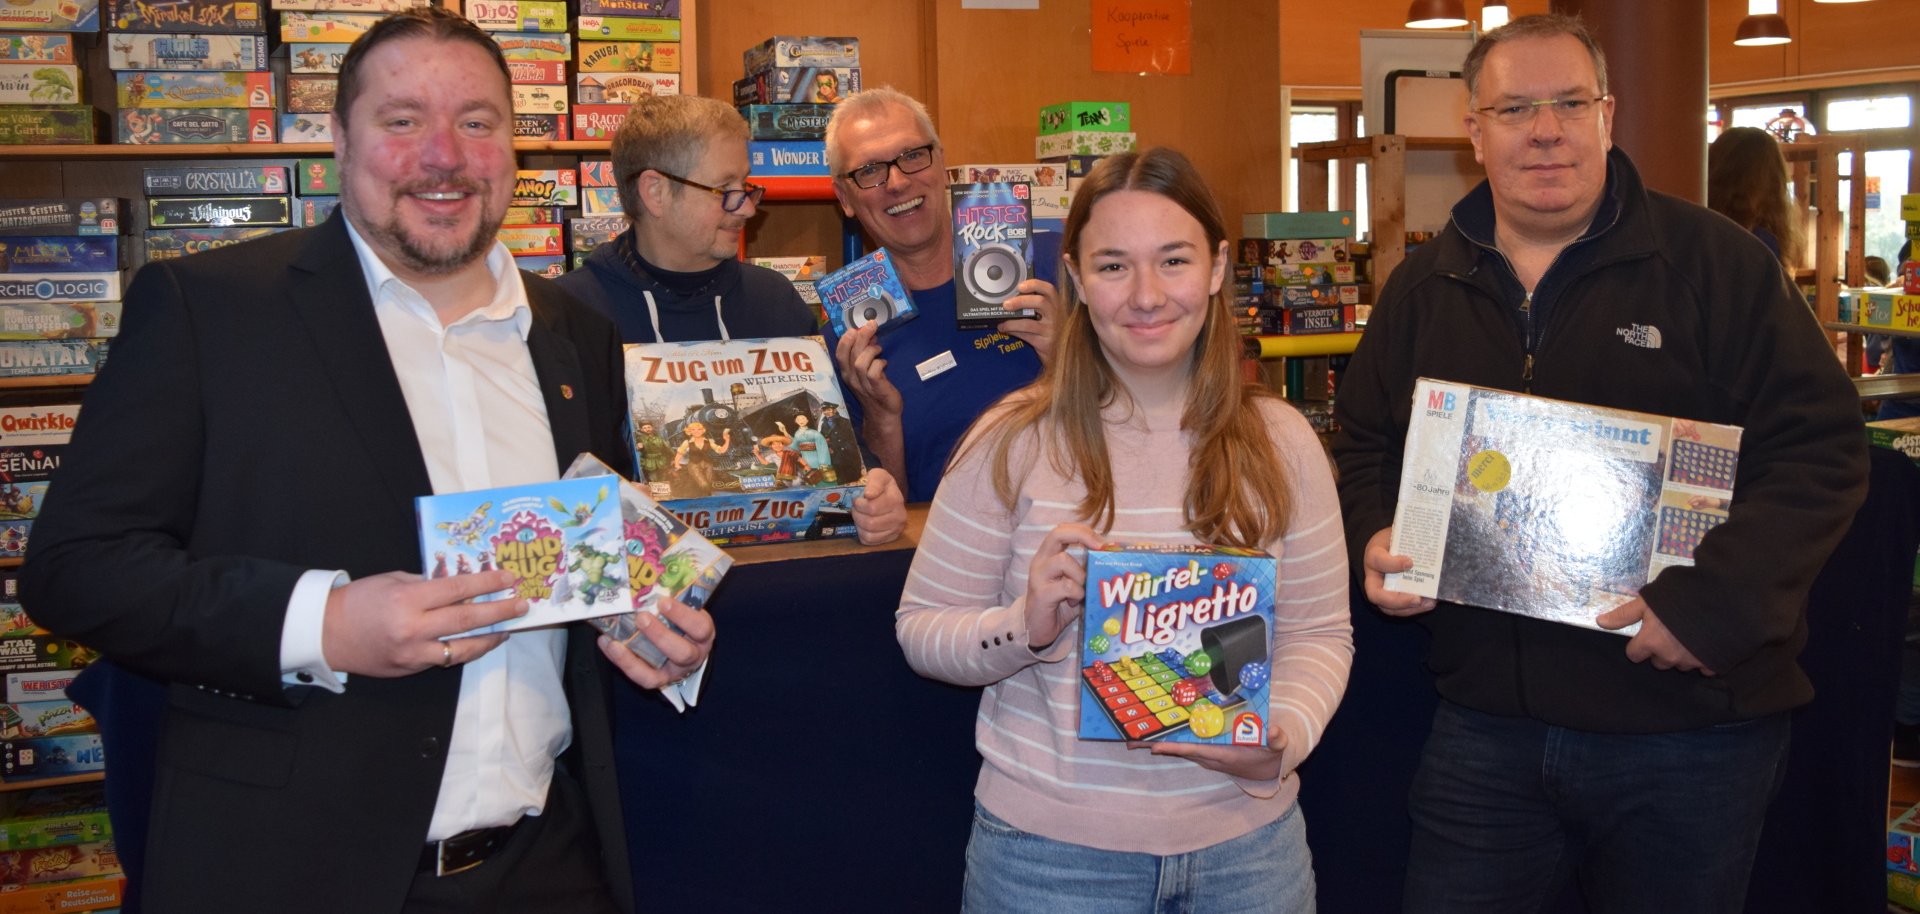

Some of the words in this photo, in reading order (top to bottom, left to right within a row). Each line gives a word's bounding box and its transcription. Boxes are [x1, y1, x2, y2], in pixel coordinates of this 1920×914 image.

[257, 37, 265, 68] KOSMOS
[583, 45, 618, 68] KARUBA
[656, 48, 675, 56] HABA
[656, 79, 675, 87] HABA
[14, 124, 55, 135] Garten
[172, 121, 188, 129] CAFE
[188, 121, 200, 129] DEL
[771, 147, 819, 166] WONDER
[186, 170, 257, 192] CRYSTALLA
[1037, 197, 1059, 209] Dream
[188, 202, 252, 223] Villainous
[957, 205, 1027, 224] HITSTER
[958, 221, 1008, 250] ROCK
[1336, 265, 1352, 273] HABA
[827, 264, 888, 306] HITSTER
[1304, 308, 1339, 318] VERBOTENE
[1304, 317, 1332, 329] INSEL
[1632, 323, 1648, 333] THE
[1616, 328, 1648, 341] NORTH
[998, 340, 1025, 355] Team
[1624, 337, 1647, 348] FACE
[640, 356, 709, 384] ZUG
[747, 348, 815, 376] ZUG
[743, 374, 817, 387] WELTREISE
[1427, 389, 1457, 412] MB
[1, 412, 75, 432] Qwirkle
[1425, 409, 1453, 420] SPIELE
[1471, 451, 1496, 480] merci
[743, 481, 774, 489] WONDER
[1428, 485, 1450, 496] Jahre
[748, 498, 805, 522] ZUG
[496, 535, 562, 562] MIND
[502, 554, 558, 579] BUG
[1100, 560, 1208, 608] Würfel-
[1122, 580, 1258, 645] Ligretto
[0, 639, 36, 648] STAR
[21, 680, 46, 691] WER
[60, 893, 116, 908] Deutschland
[66, 889, 90, 898] Reise
